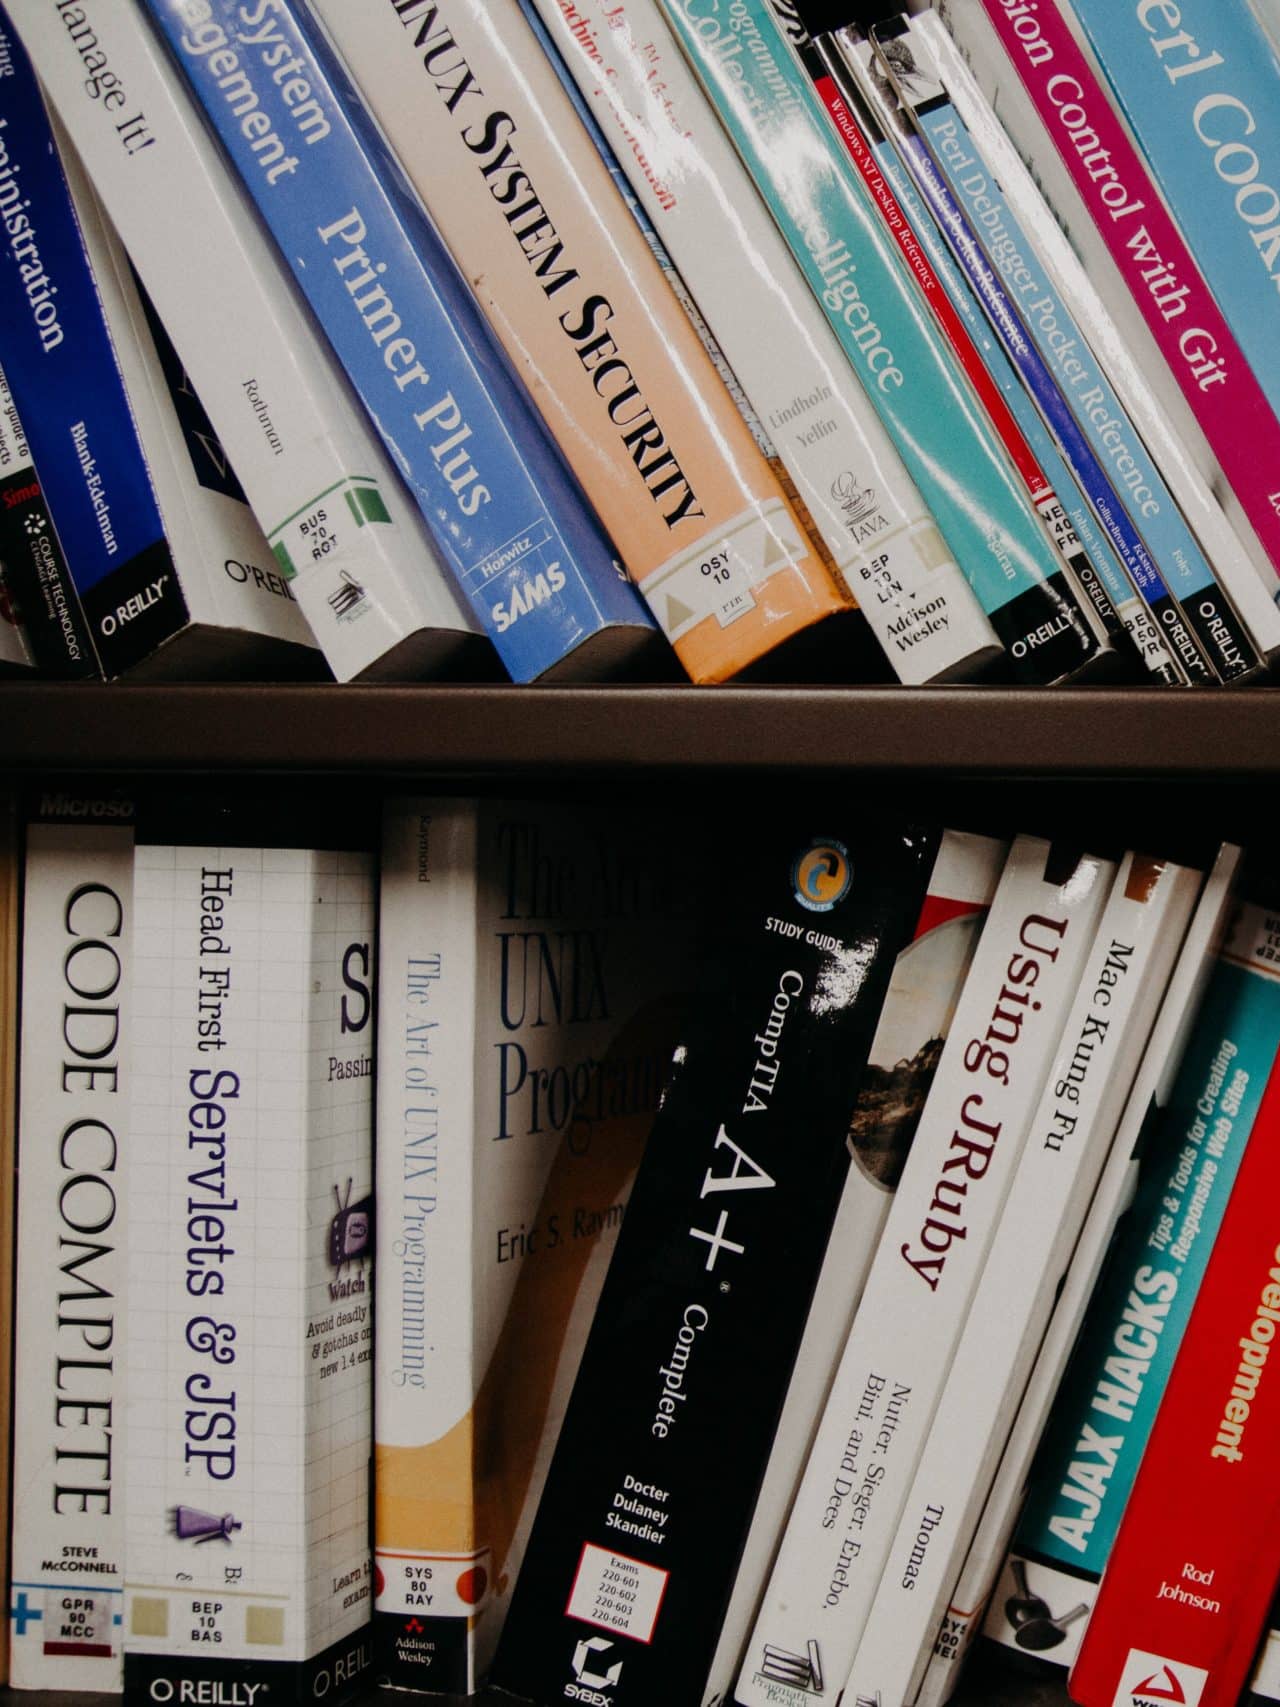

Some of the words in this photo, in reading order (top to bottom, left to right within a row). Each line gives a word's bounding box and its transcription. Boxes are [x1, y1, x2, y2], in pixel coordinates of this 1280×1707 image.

[830, 97, 866, 158] Windows
[857, 154, 878, 175] NT
[869, 173, 903, 228] Desktop
[899, 227, 936, 291] Reference
[1046, 74, 1145, 222] Control
[1124, 225, 1191, 322] with
[1179, 327, 1226, 393] Git
[460, 110, 581, 301] SYSTEM
[558, 294, 706, 530] SECURITY
[931, 119, 965, 169] Perl
[960, 174, 1039, 297] Debugger
[1029, 290, 1090, 387] Pocket
[1078, 386, 1161, 518] Reference
[317, 205, 430, 393] Primer
[412, 391, 492, 517] Plus
[70, 420, 119, 555] Blank-Edelman
[199, 866, 234, 957] Head
[764, 916, 804, 940] STUDY
[805, 929, 844, 953] GUIDE
[61, 881, 124, 1094] CODE
[197, 967, 231, 1053] First
[963, 913, 1069, 1087] Using
[1092, 939, 1136, 1008] Mac
[1054, 1013, 1110, 1109] Kung
[1043, 1110, 1080, 1153] Fu
[186, 1068, 241, 1298] Servlets
[900, 1094, 1002, 1292] JRuby
[54, 1117, 118, 1516] COMPLETE
[184, 1315, 238, 1365] &
[651, 1302, 709, 1440] Complete
[1048, 1423, 1125, 1553] AJAX
[1091, 1264, 1178, 1420] HACKS
[613, 1493, 669, 1527] Dulaney
[623, 1473, 670, 1503] Docter
[61, 1546, 100, 1559] STEVE
[605, 1512, 666, 1545] Skandier
[609, 1556, 640, 1576] Exams
[901, 1503, 944, 1592] Thomas
[41, 1560, 118, 1575] McCONNELL
[602, 1568, 641, 1590] 220-601
[1156, 1581, 1221, 1614] Johnson
[1181, 1562, 1215, 1586] Rod
[190, 1630, 223, 1644] BAS
[191, 1602, 223, 1615] BEP
[198, 1616, 216, 1629] 10
[591, 1607, 629, 1629] 220-604
